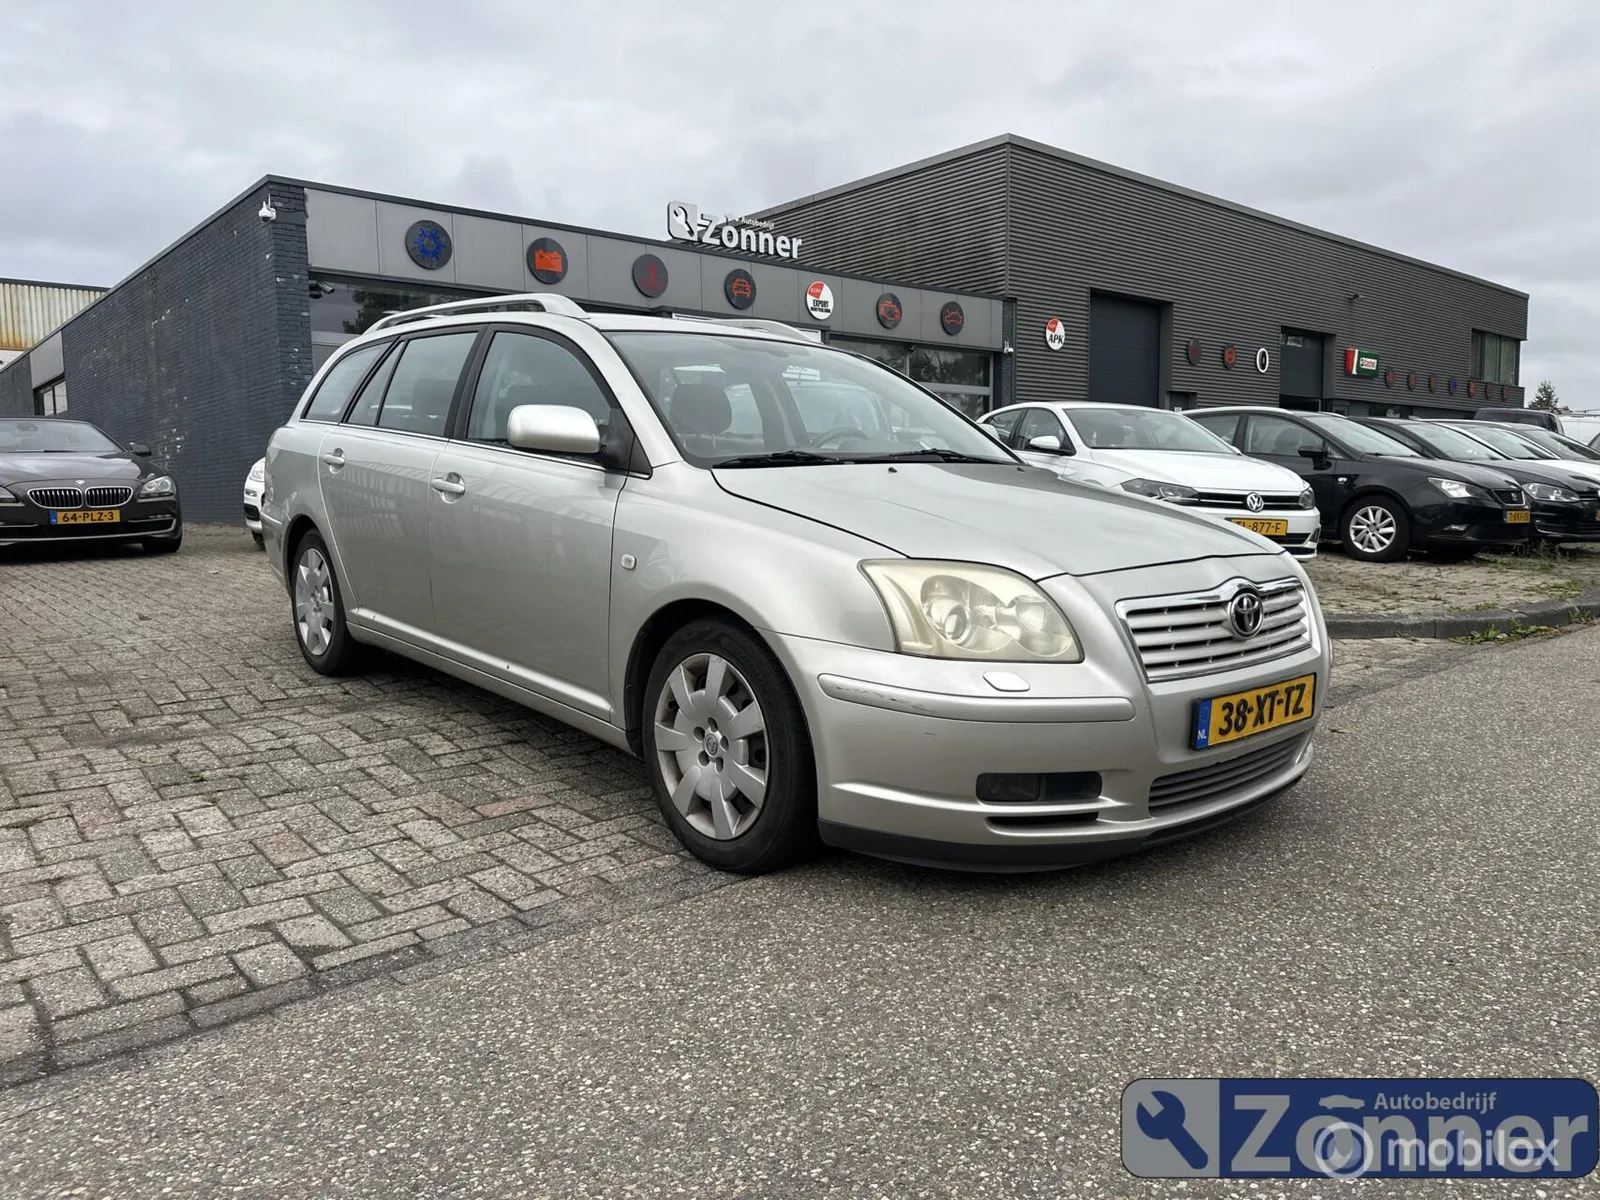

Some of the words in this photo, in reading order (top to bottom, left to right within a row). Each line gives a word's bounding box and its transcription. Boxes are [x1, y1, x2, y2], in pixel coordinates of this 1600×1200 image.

[741, 216, 775, 231] Autobedrijf
[700, 213, 803, 259] Zonner
[1049, 333, 1064, 344] APK
[62, 511, 115, 523] 64-PLZ-3
[1218, 683, 1307, 736] 38-XT-TZ
[1197, 728, 1208, 741] NL
